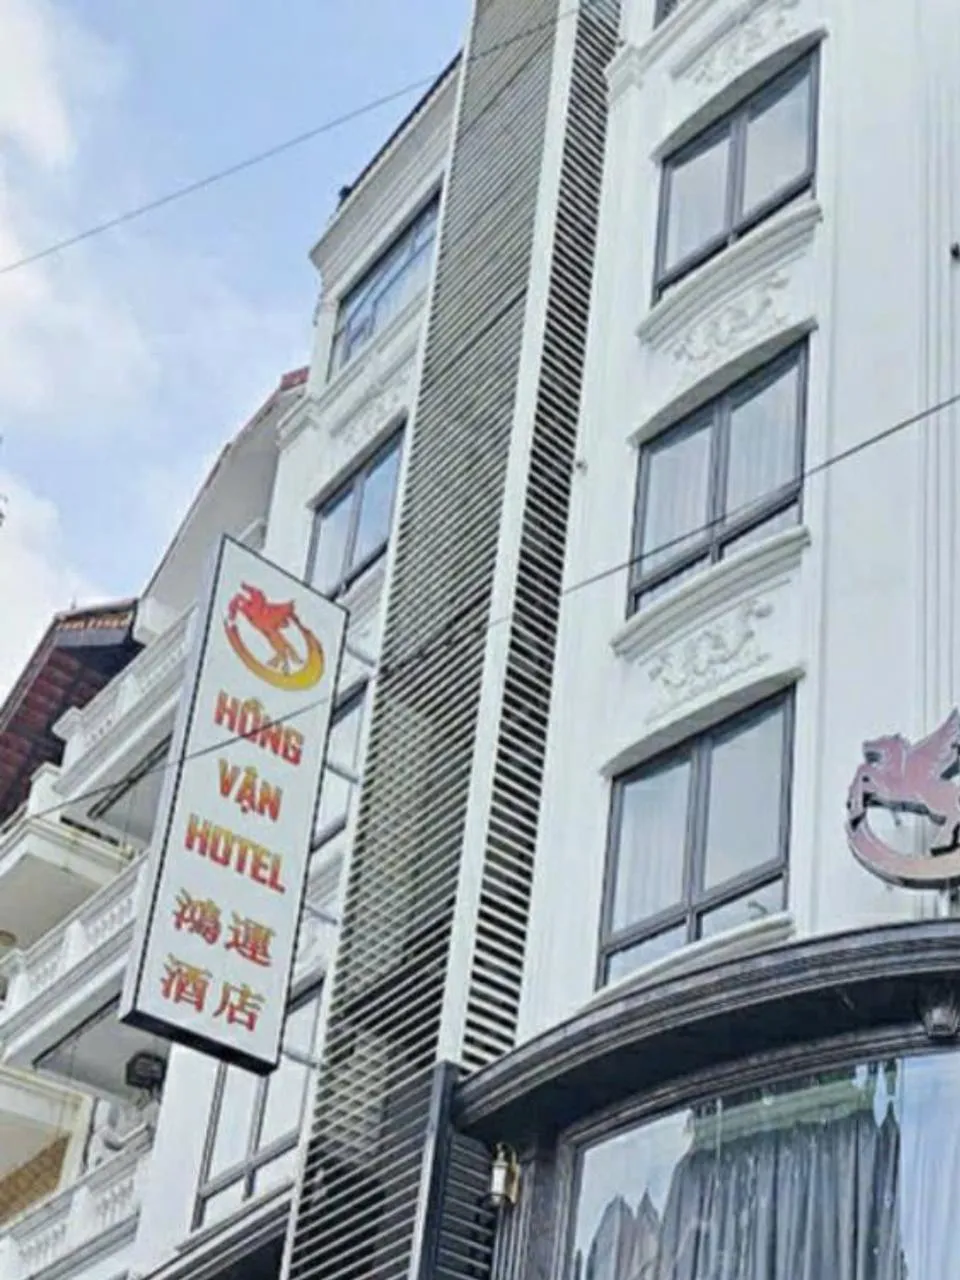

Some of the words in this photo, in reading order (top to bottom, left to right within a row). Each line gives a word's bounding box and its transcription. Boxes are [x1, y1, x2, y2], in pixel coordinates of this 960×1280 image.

[185, 812, 285, 894] HOTEL
[173, 886, 276, 968] 鴻運
[160, 952, 266, 1033] 酒店
